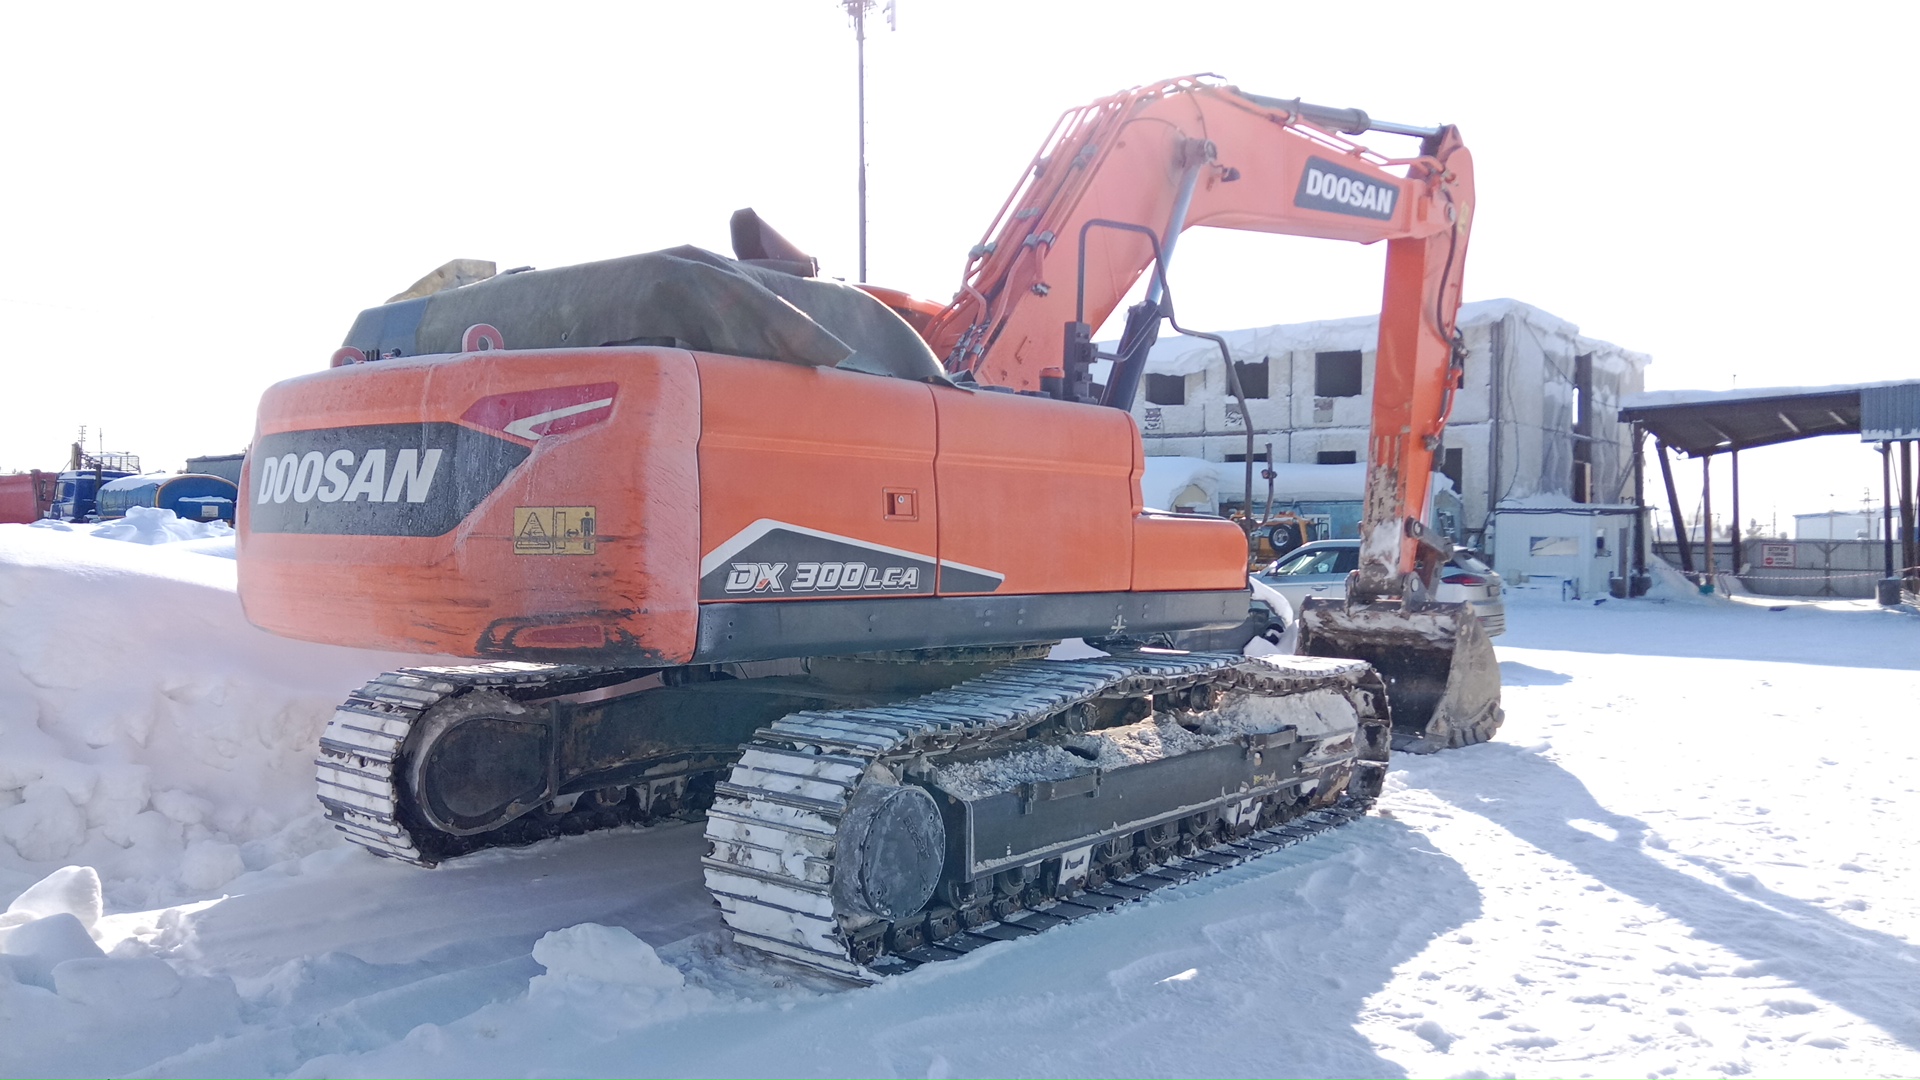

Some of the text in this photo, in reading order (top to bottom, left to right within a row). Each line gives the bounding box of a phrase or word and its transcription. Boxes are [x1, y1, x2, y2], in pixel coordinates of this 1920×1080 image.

[1305, 168, 1393, 214] DOOSAN
[257, 449, 443, 505] DOOSAN
[725, 563, 788, 593] DX
